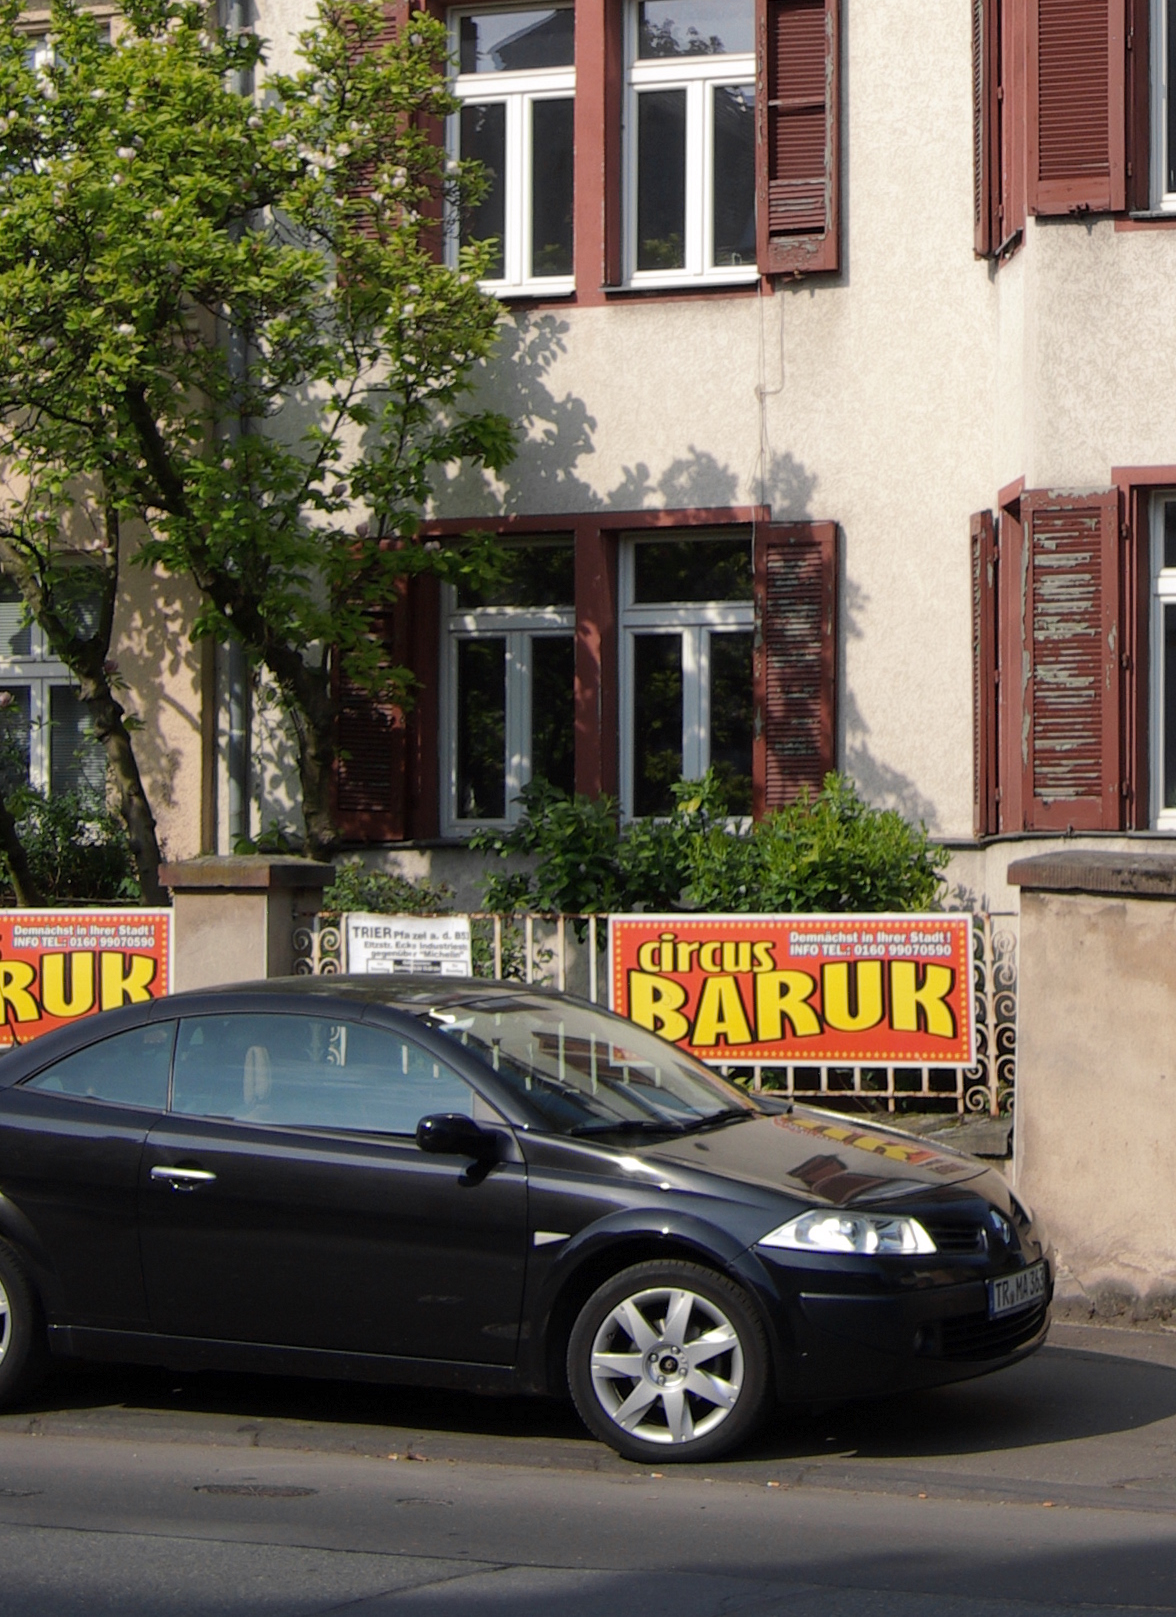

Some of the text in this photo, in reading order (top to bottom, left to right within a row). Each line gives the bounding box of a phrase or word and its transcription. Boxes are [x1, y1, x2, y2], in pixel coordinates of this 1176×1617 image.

[13, 924, 74, 936] Demnächst
[76, 924, 87, 936] in
[90, 924, 116, 936] Ihrer
[352, 926, 392, 939] TRIER
[13, 936, 156, 948] INFO TEL.: 0160 99070590
[789, 931, 858, 944] Demnächst
[861, 932, 874, 944] in
[877, 932, 906, 944] Ihrer
[638, 932, 775, 973] circus
[789, 944, 952, 956] INFO TEL.: 0160 99070590
[0, 951, 157, 1024] RUK
[628, 959, 956, 1047] BARUK
[995, 1280, 1009, 1308] TR
